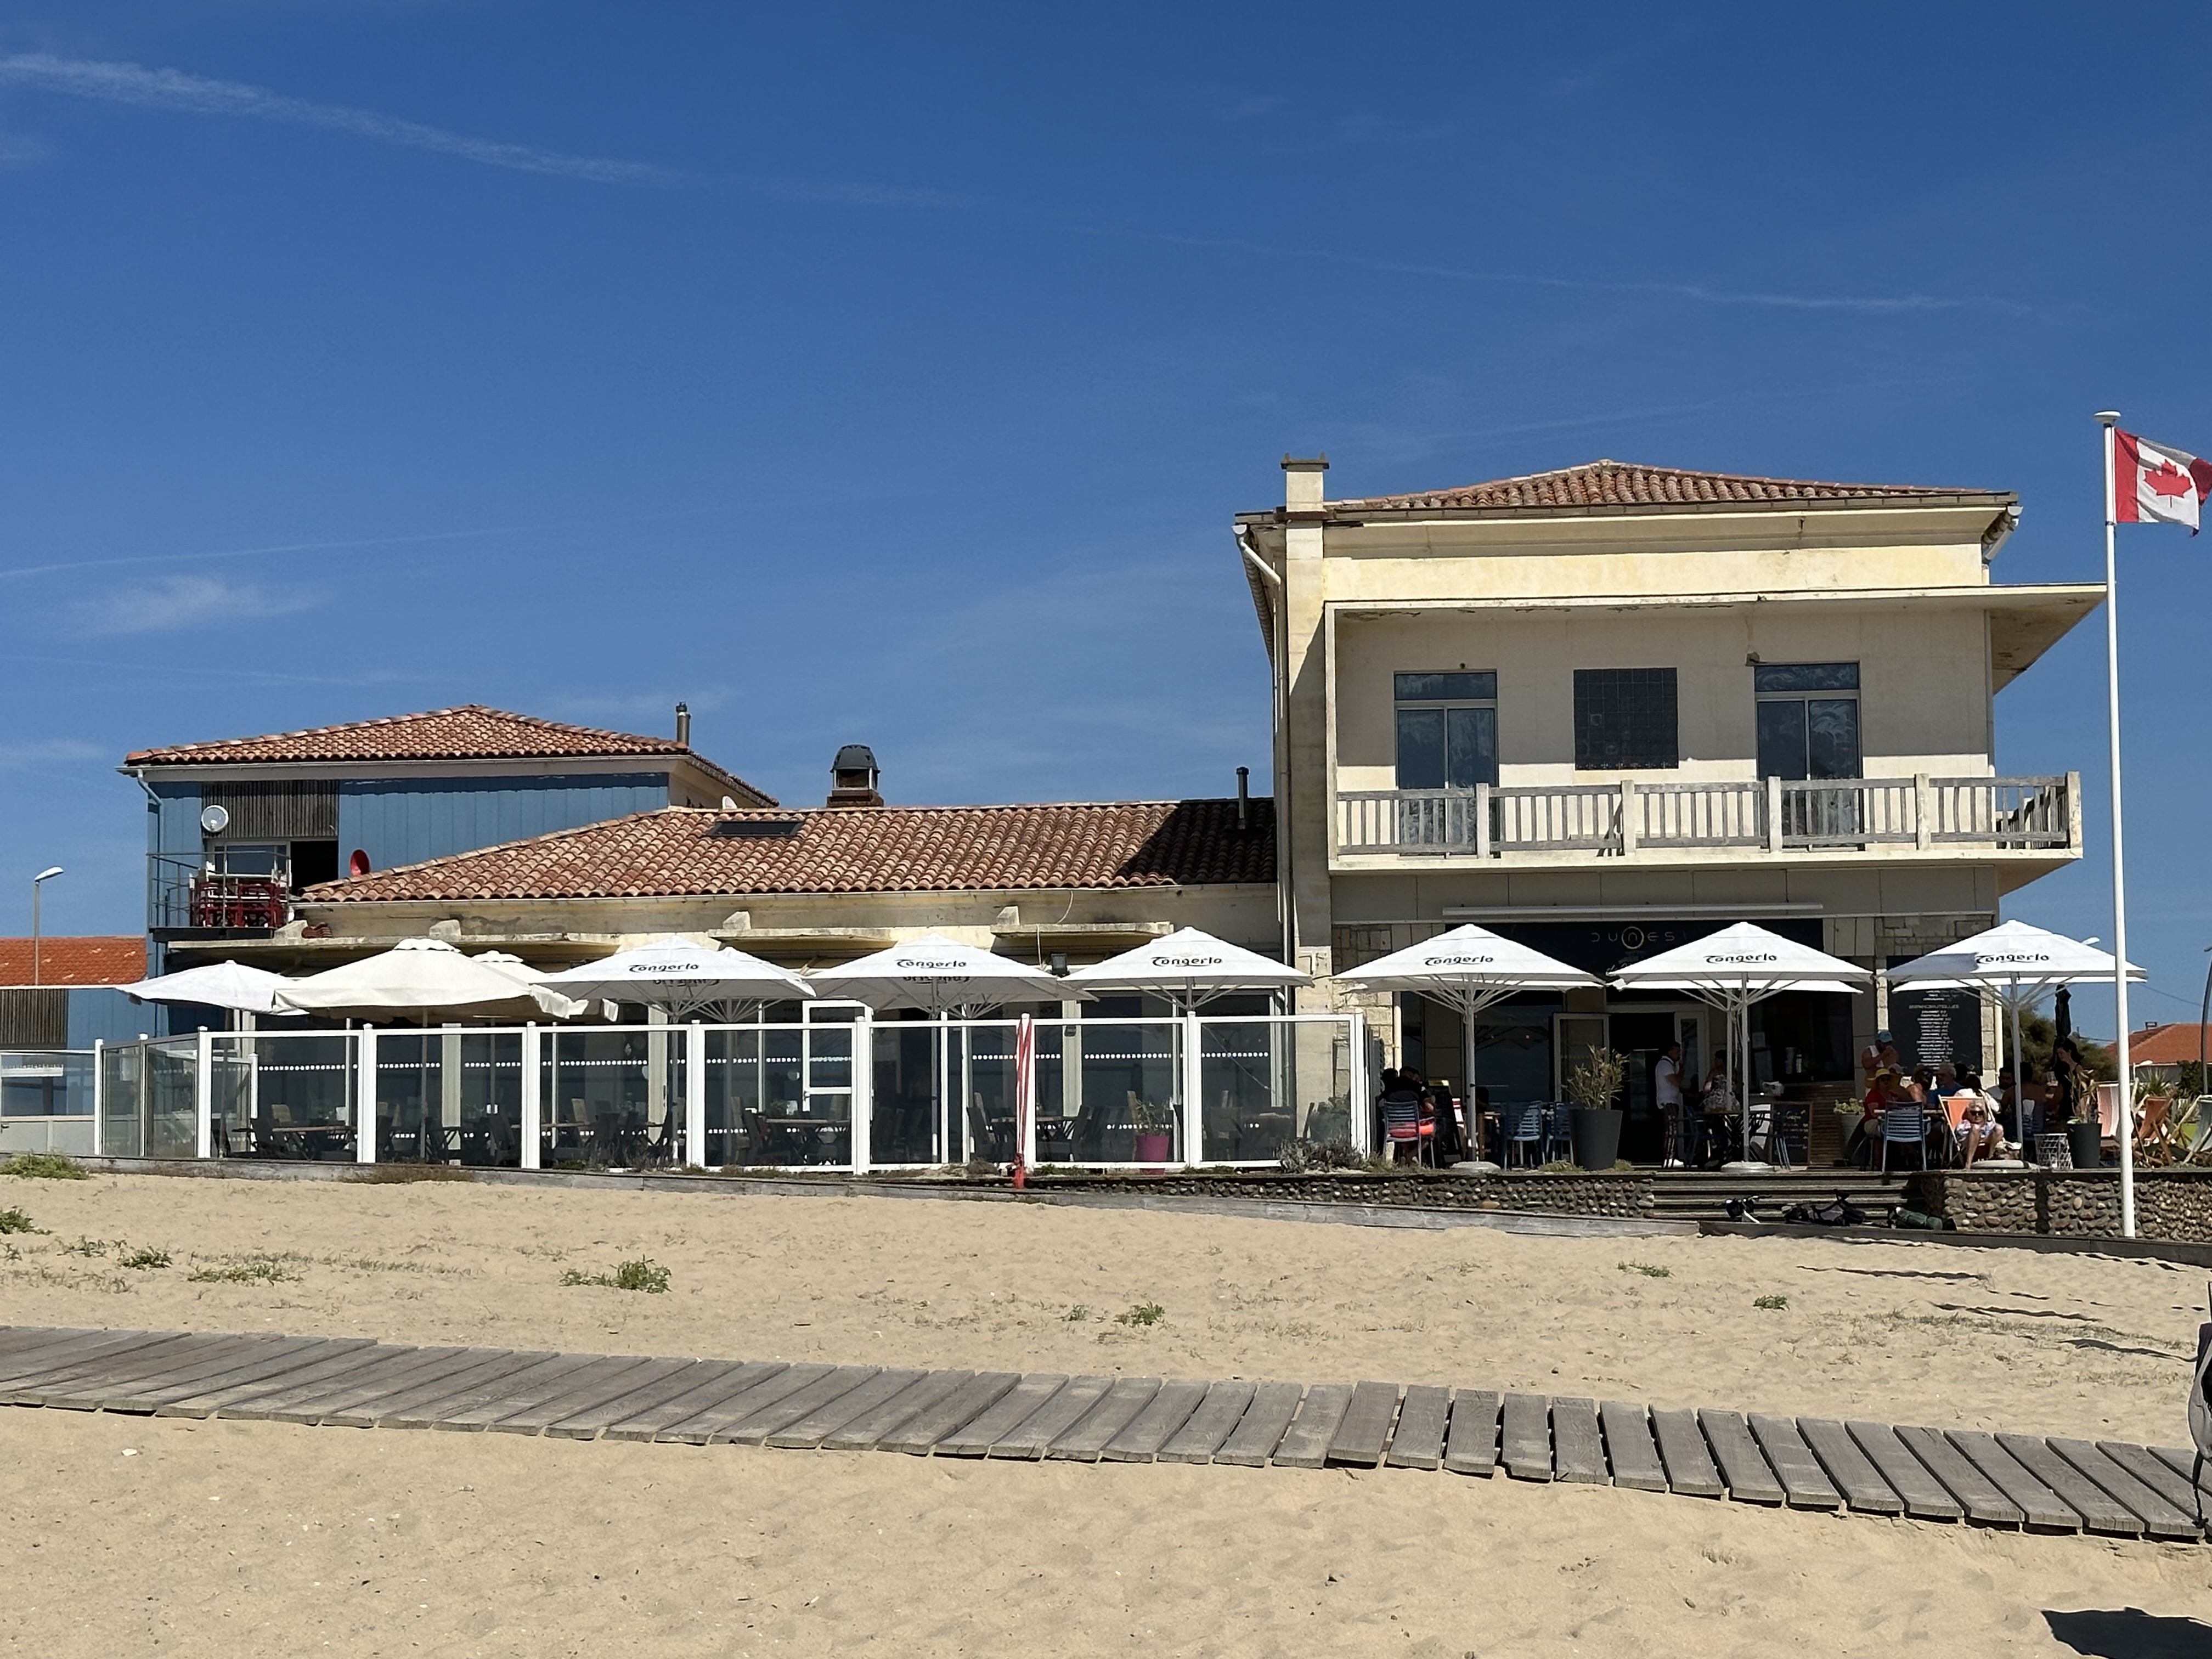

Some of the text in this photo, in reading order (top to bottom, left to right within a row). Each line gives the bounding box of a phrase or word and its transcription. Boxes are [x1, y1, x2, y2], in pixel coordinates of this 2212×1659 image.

[1150, 957, 1222, 967] Tongerlo
[1423, 956, 1494, 966] Tongerlo
[1703, 953, 1778, 964] Tongerlo
[1975, 953, 2050, 964] Tongerlo
[628, 963, 699, 973] Tongerlo
[894, 960, 967, 969] Tongerlo
